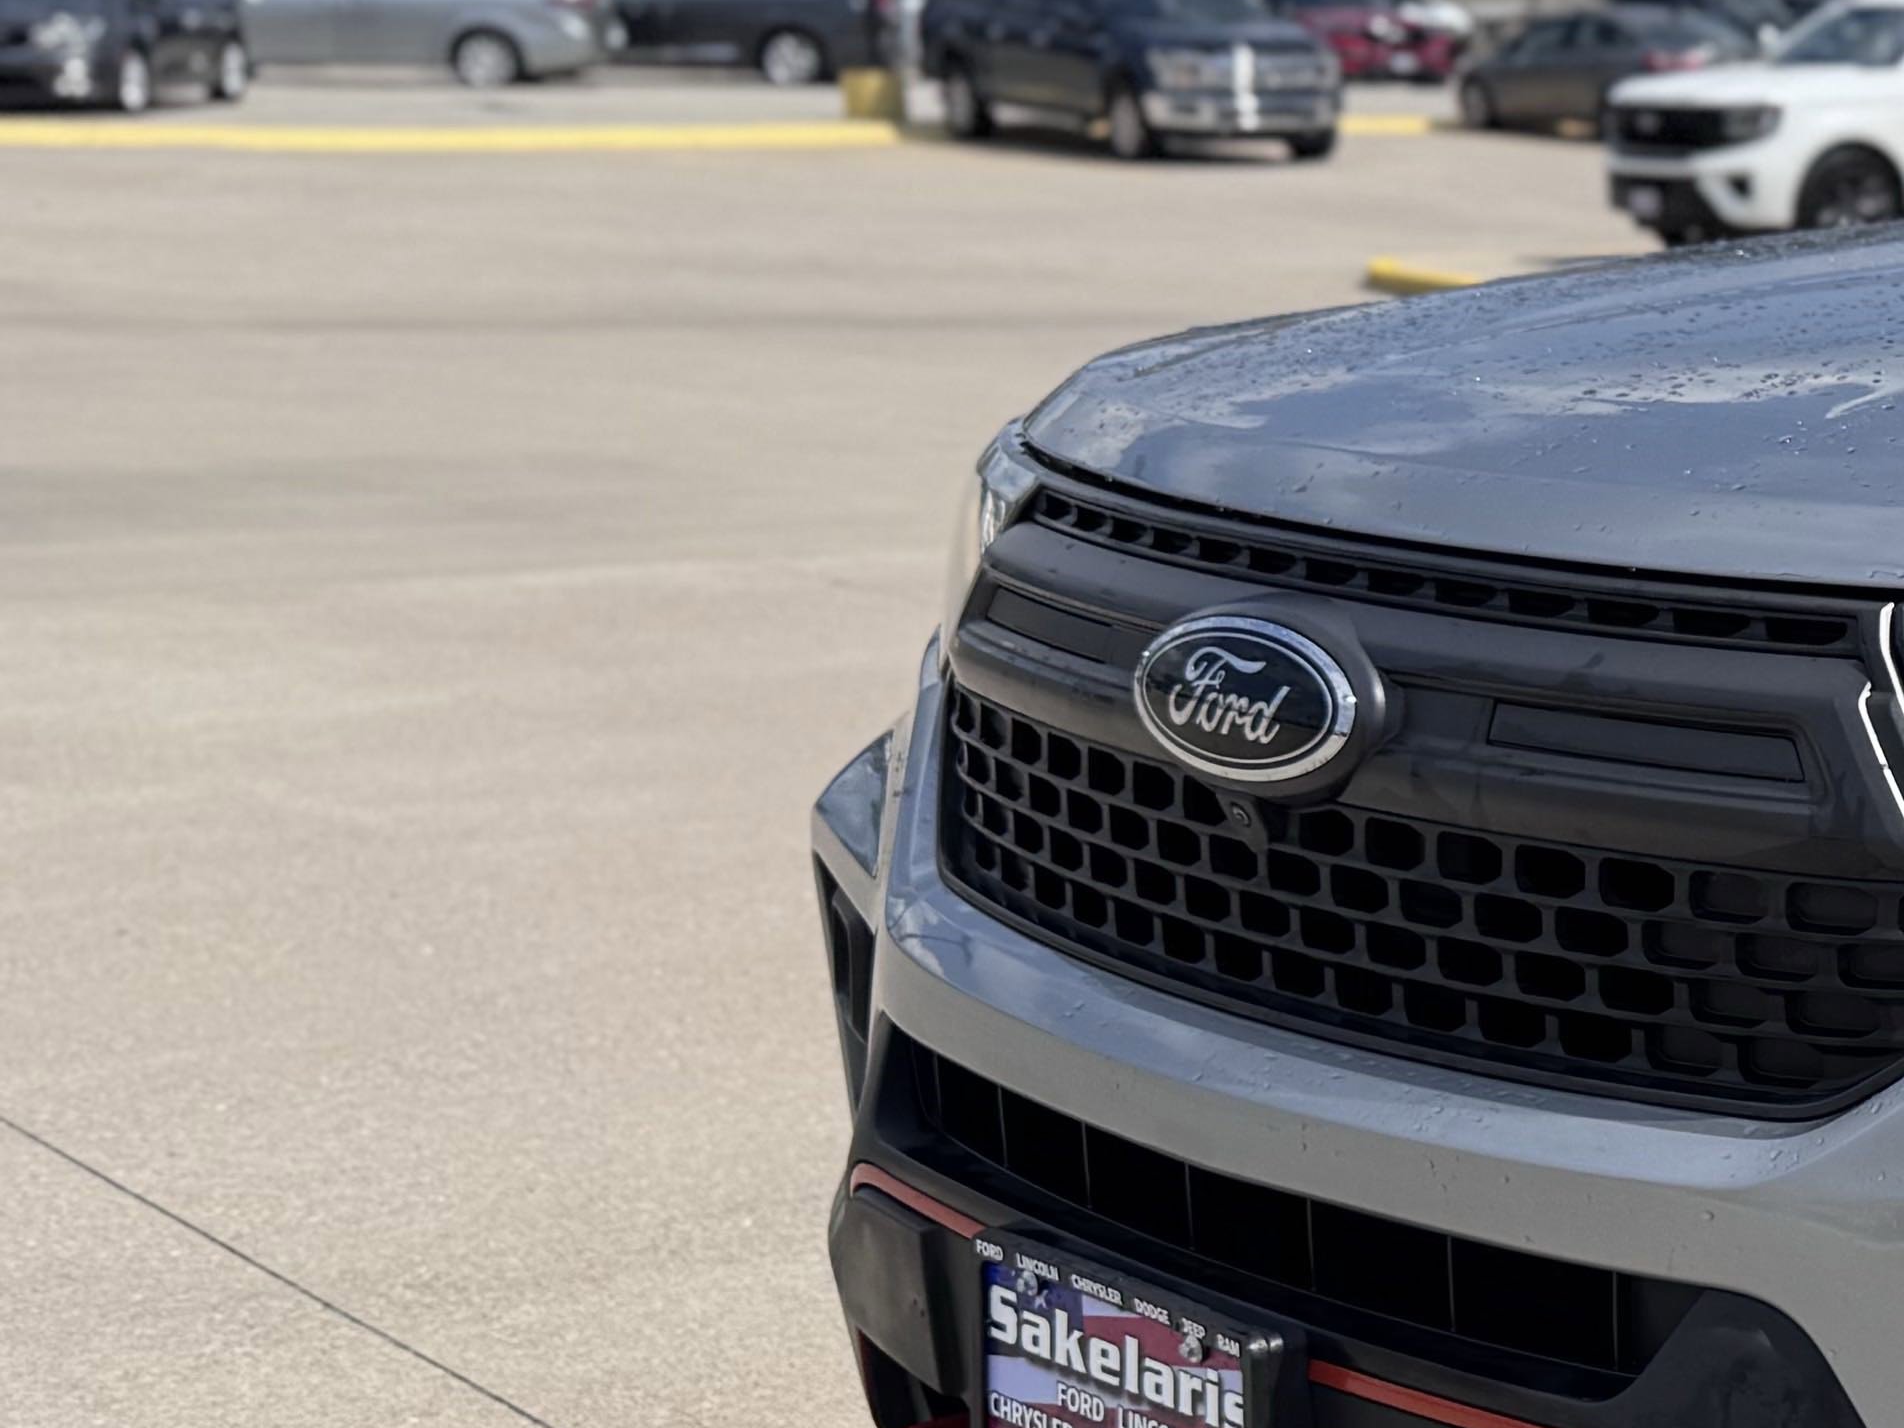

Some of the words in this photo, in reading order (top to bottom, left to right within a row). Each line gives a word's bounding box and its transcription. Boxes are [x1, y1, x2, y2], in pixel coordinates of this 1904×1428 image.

[1167, 645, 1293, 746] Ford
[975, 1239, 1004, 1261] FORD
[1016, 1252, 1059, 1281] LINCOLN
[1070, 1274, 1123, 1306] CHRYSLER
[1133, 1298, 1171, 1325] DODGE
[1181, 1317, 1206, 1340] JEEP
[1216, 1333, 1241, 1358] RAM
[1056, 1381, 1105, 1422] FORD
